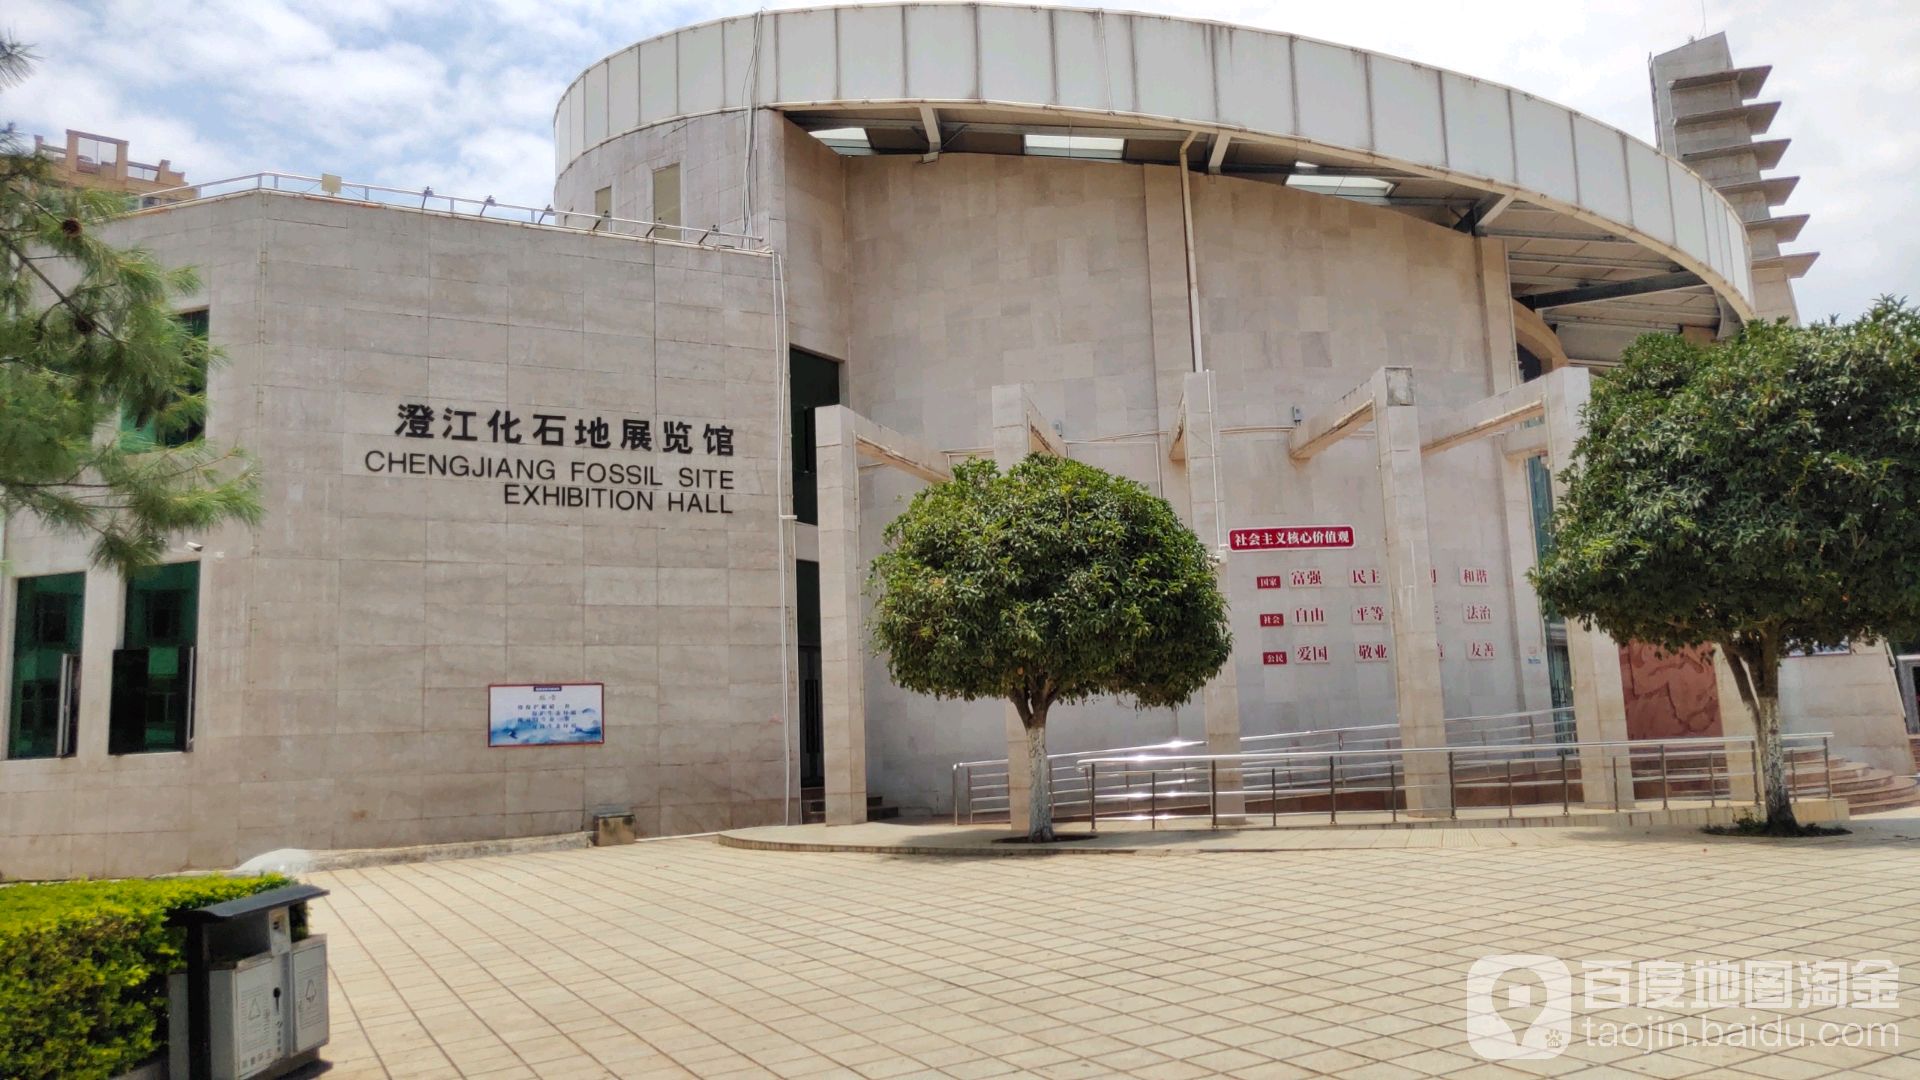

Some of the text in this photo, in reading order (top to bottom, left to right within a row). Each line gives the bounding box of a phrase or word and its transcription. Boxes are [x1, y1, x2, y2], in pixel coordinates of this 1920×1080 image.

[394, 403, 735, 457] 澄江化石地展览馆
[364, 449, 734, 489] CHENGJIANG FOSSIL SITE
[504, 484, 734, 514] EXHIBITION HALL
[1234, 529, 1350, 546] 社会主义核心价值观
[1260, 568, 1487, 587] 国家 富强 民主 和谐
[1263, 605, 1491, 625] 社会 自由 平等 法治
[1267, 642, 1495, 663] 公民 爱国 敬业 友善
